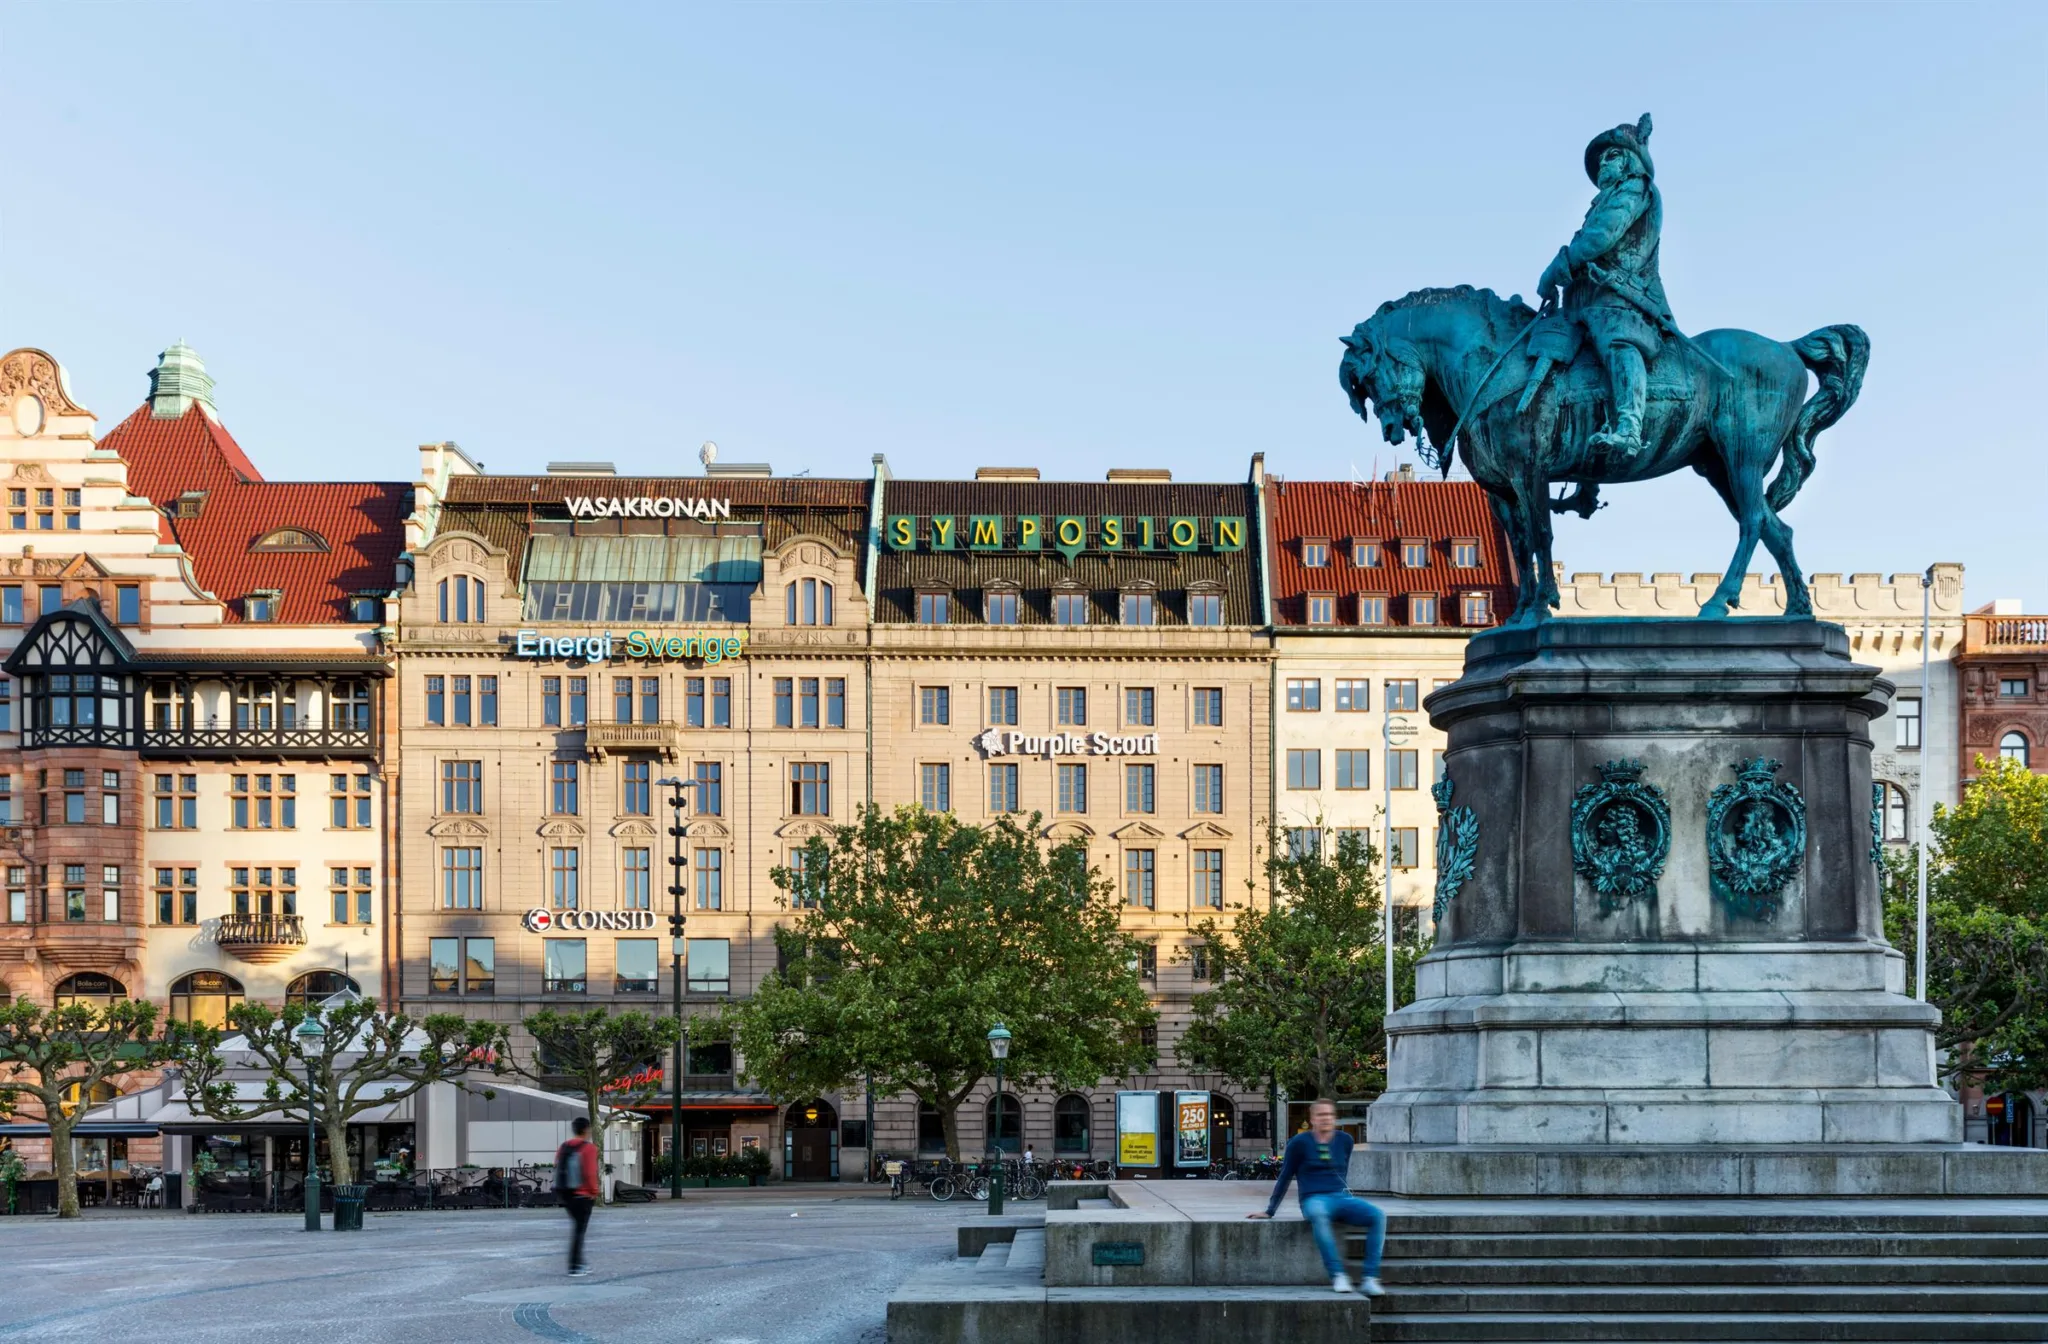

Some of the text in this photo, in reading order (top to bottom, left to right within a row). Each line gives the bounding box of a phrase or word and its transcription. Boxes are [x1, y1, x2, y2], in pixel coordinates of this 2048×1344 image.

[564, 496, 730, 518] VASAKRONAN
[895, 518, 1241, 547] SYMPOSION
[432, 628, 485, 641] BANK
[781, 630, 833, 642] BANK
[516, 629, 743, 664] Energi Sverige
[1008, 732, 1161, 758] Purple Scout
[560, 910, 657, 930] CONSID
[1182, 1108, 1205, 1123] 250
